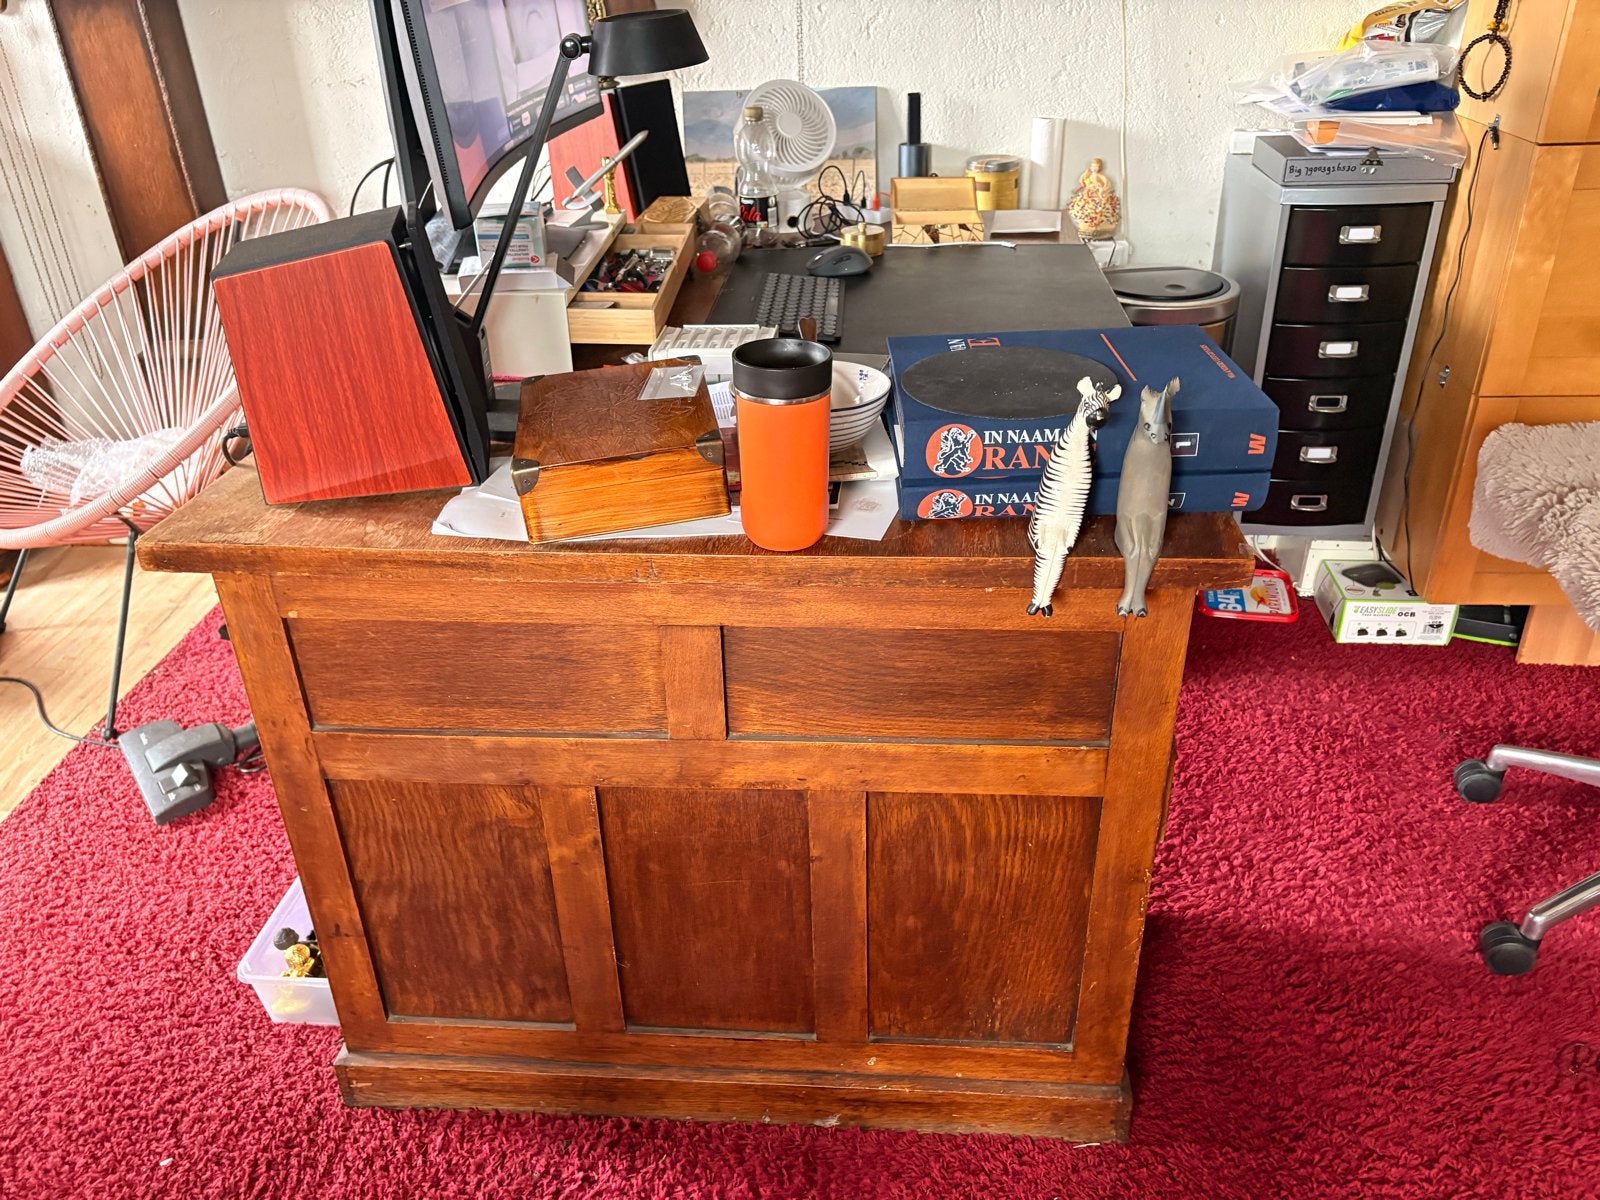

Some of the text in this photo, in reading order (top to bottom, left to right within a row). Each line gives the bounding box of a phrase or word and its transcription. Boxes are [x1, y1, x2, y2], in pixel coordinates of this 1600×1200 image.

[1289, 165, 1302, 177] Big
[983, 428, 1061, 445] IN NAAM
[974, 491, 1039, 505] IN NAA
